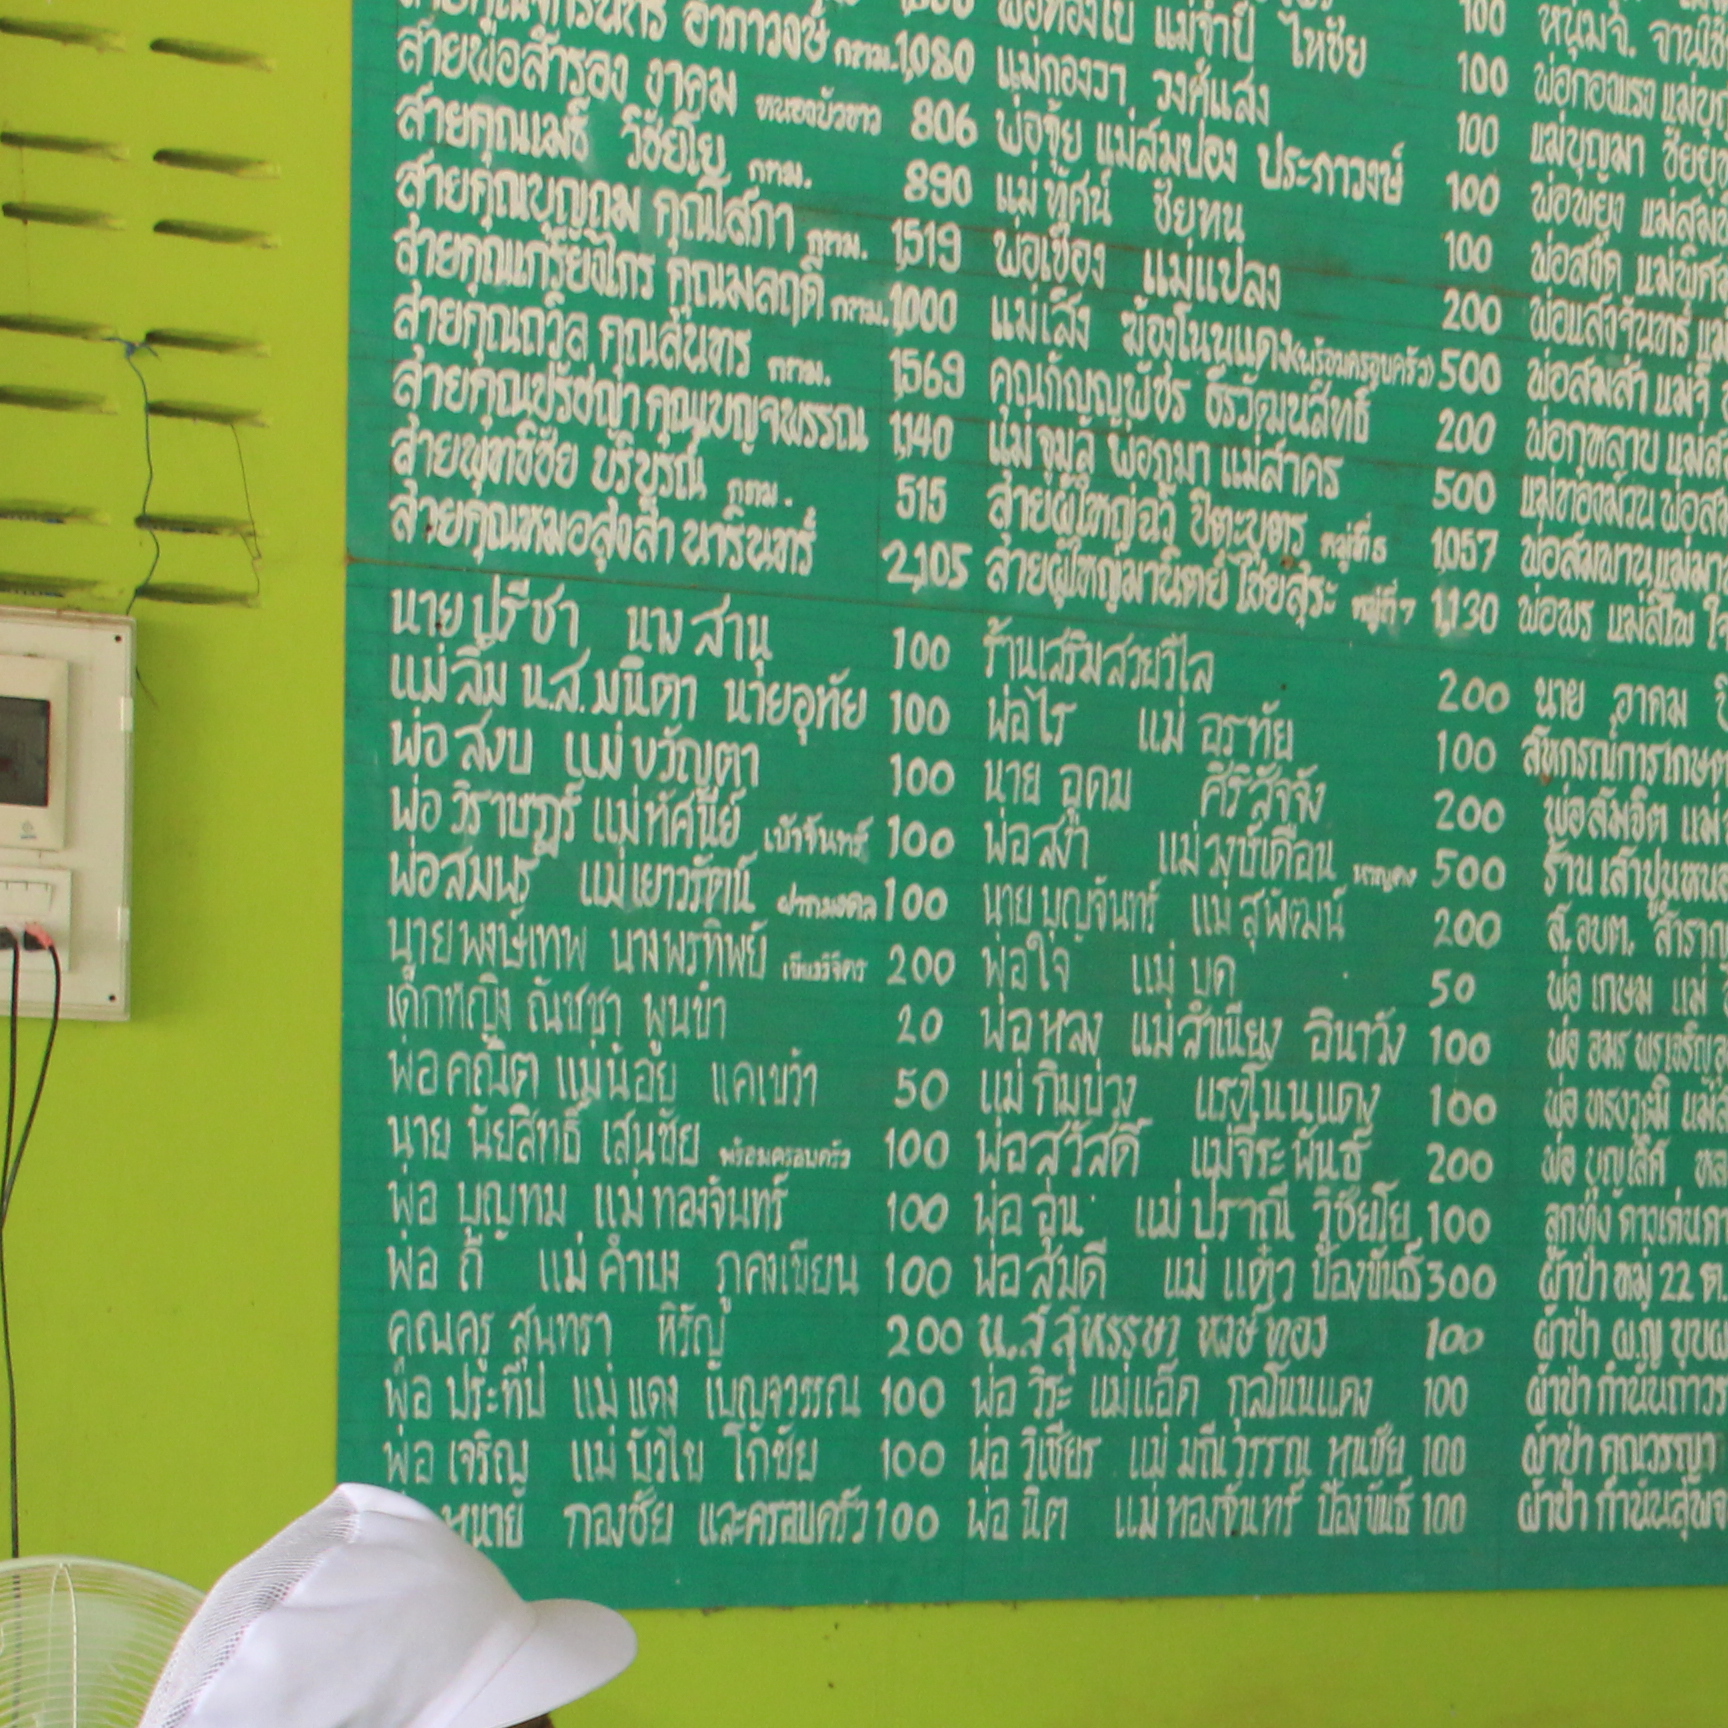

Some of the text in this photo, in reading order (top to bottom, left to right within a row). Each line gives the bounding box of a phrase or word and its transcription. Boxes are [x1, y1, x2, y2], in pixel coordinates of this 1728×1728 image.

[1458, 50, 1509, 97] 100
[909, 95, 979, 149] 806
[902, 158, 973, 208] 890
[1445, 170, 1501, 217] 100
[1441, 229, 1494, 273] 100
[1441, 285, 1503, 336] 200
[1436, 347, 1503, 395] 500
[894, 472, 948, 524] 515
[891, 625, 951, 671] 100
[889, 689, 952, 736] 100
[1436, 729, 1498, 773] 100
[1432, 788, 1506, 834] 200
[886, 813, 956, 860] 100
[883, 876, 949, 922] 100
[1427, 968, 1477, 1009] 50
[896, 1003, 944, 1045] 20
[893, 1066, 950, 1112] 50
[1425, 1141, 1495, 1184] 200
[885, 1191, 950, 1234] 100
[1425, 1260, 1498, 1302] 300
[1658, 1260, 1695, 1303] 22
[885, 1313, 964, 1358] 200
[879, 1375, 946, 1420] 100
[1421, 1434, 1467, 1477] 100
[1421, 1491, 1468, 1536] 100
